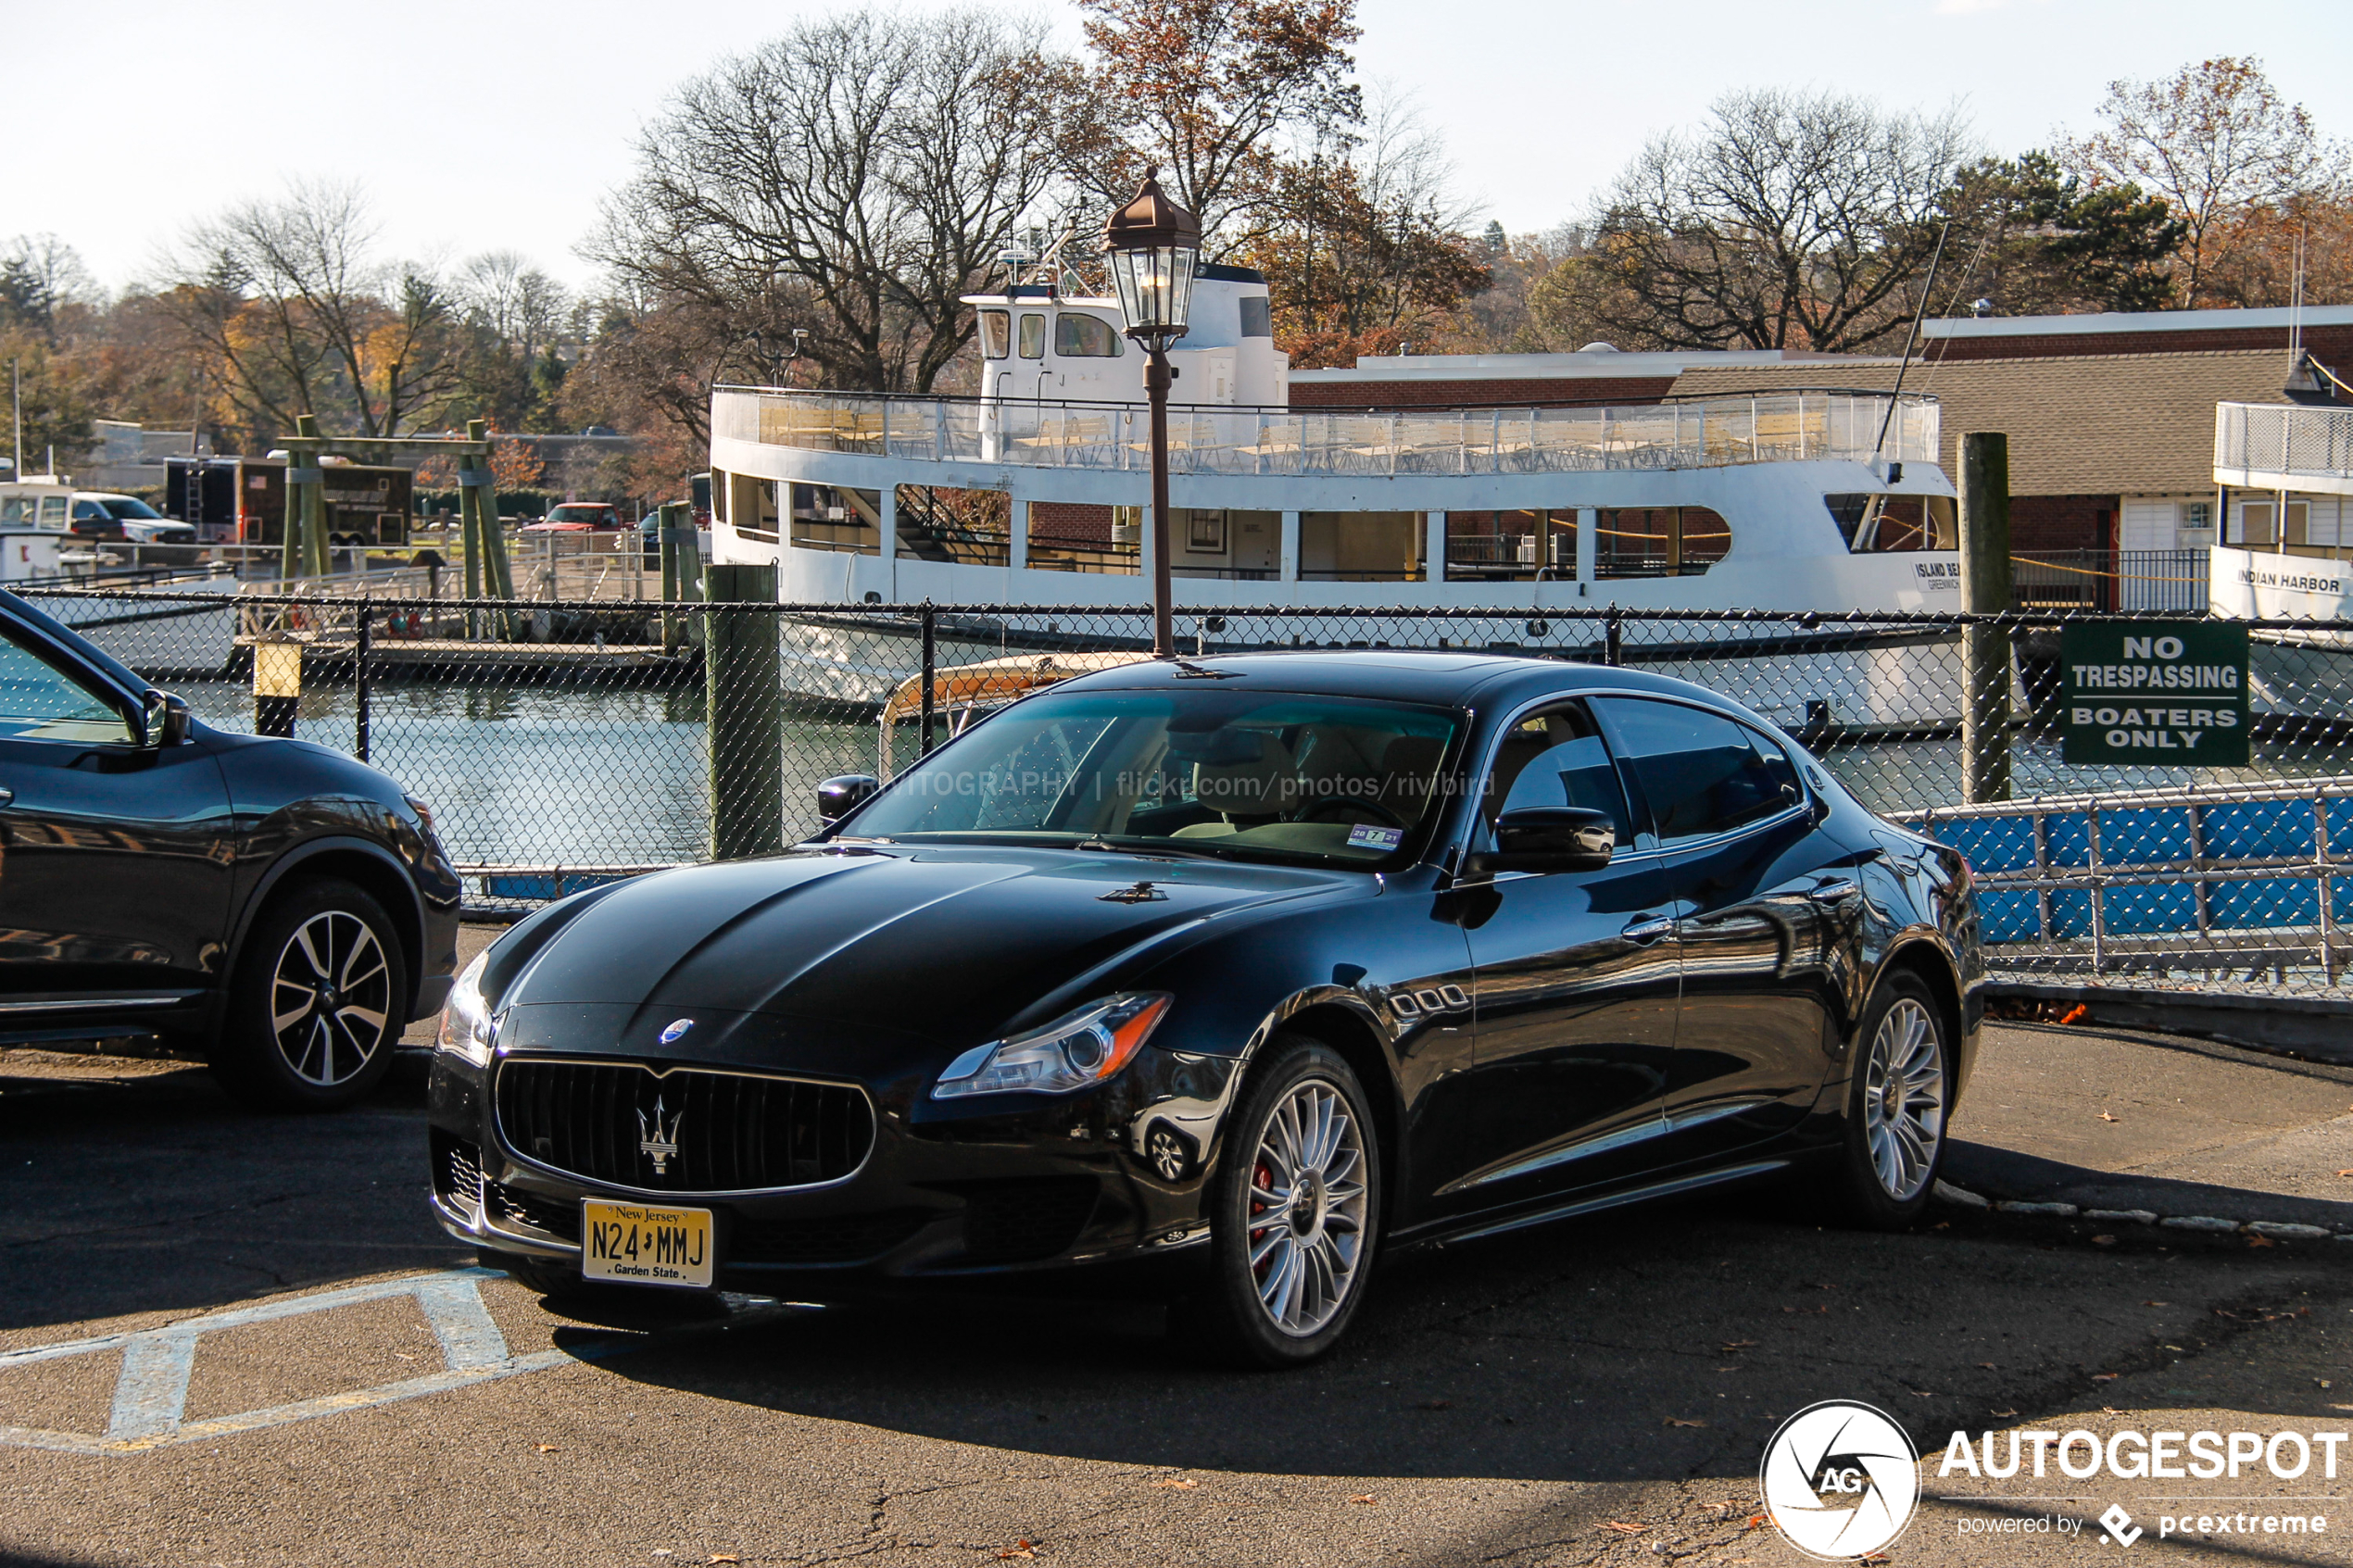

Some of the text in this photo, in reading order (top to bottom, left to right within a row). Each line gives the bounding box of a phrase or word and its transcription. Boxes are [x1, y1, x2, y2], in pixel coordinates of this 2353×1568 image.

[1915, 562, 1945, 577] ISLAND
[2238, 570, 2339, 592] INDIAN HARBOR
[2123, 636, 2183, 659] NO
[2071, 665, 2237, 688] TRESPASSING
[2071, 708, 2237, 727] BOATERS
[2105, 730, 2202, 748] ONLY
[616, 1206, 680, 1225] New Jersey
[592, 1221, 704, 1266] N24 MMJ
[614, 1263, 679, 1278] Garden State
